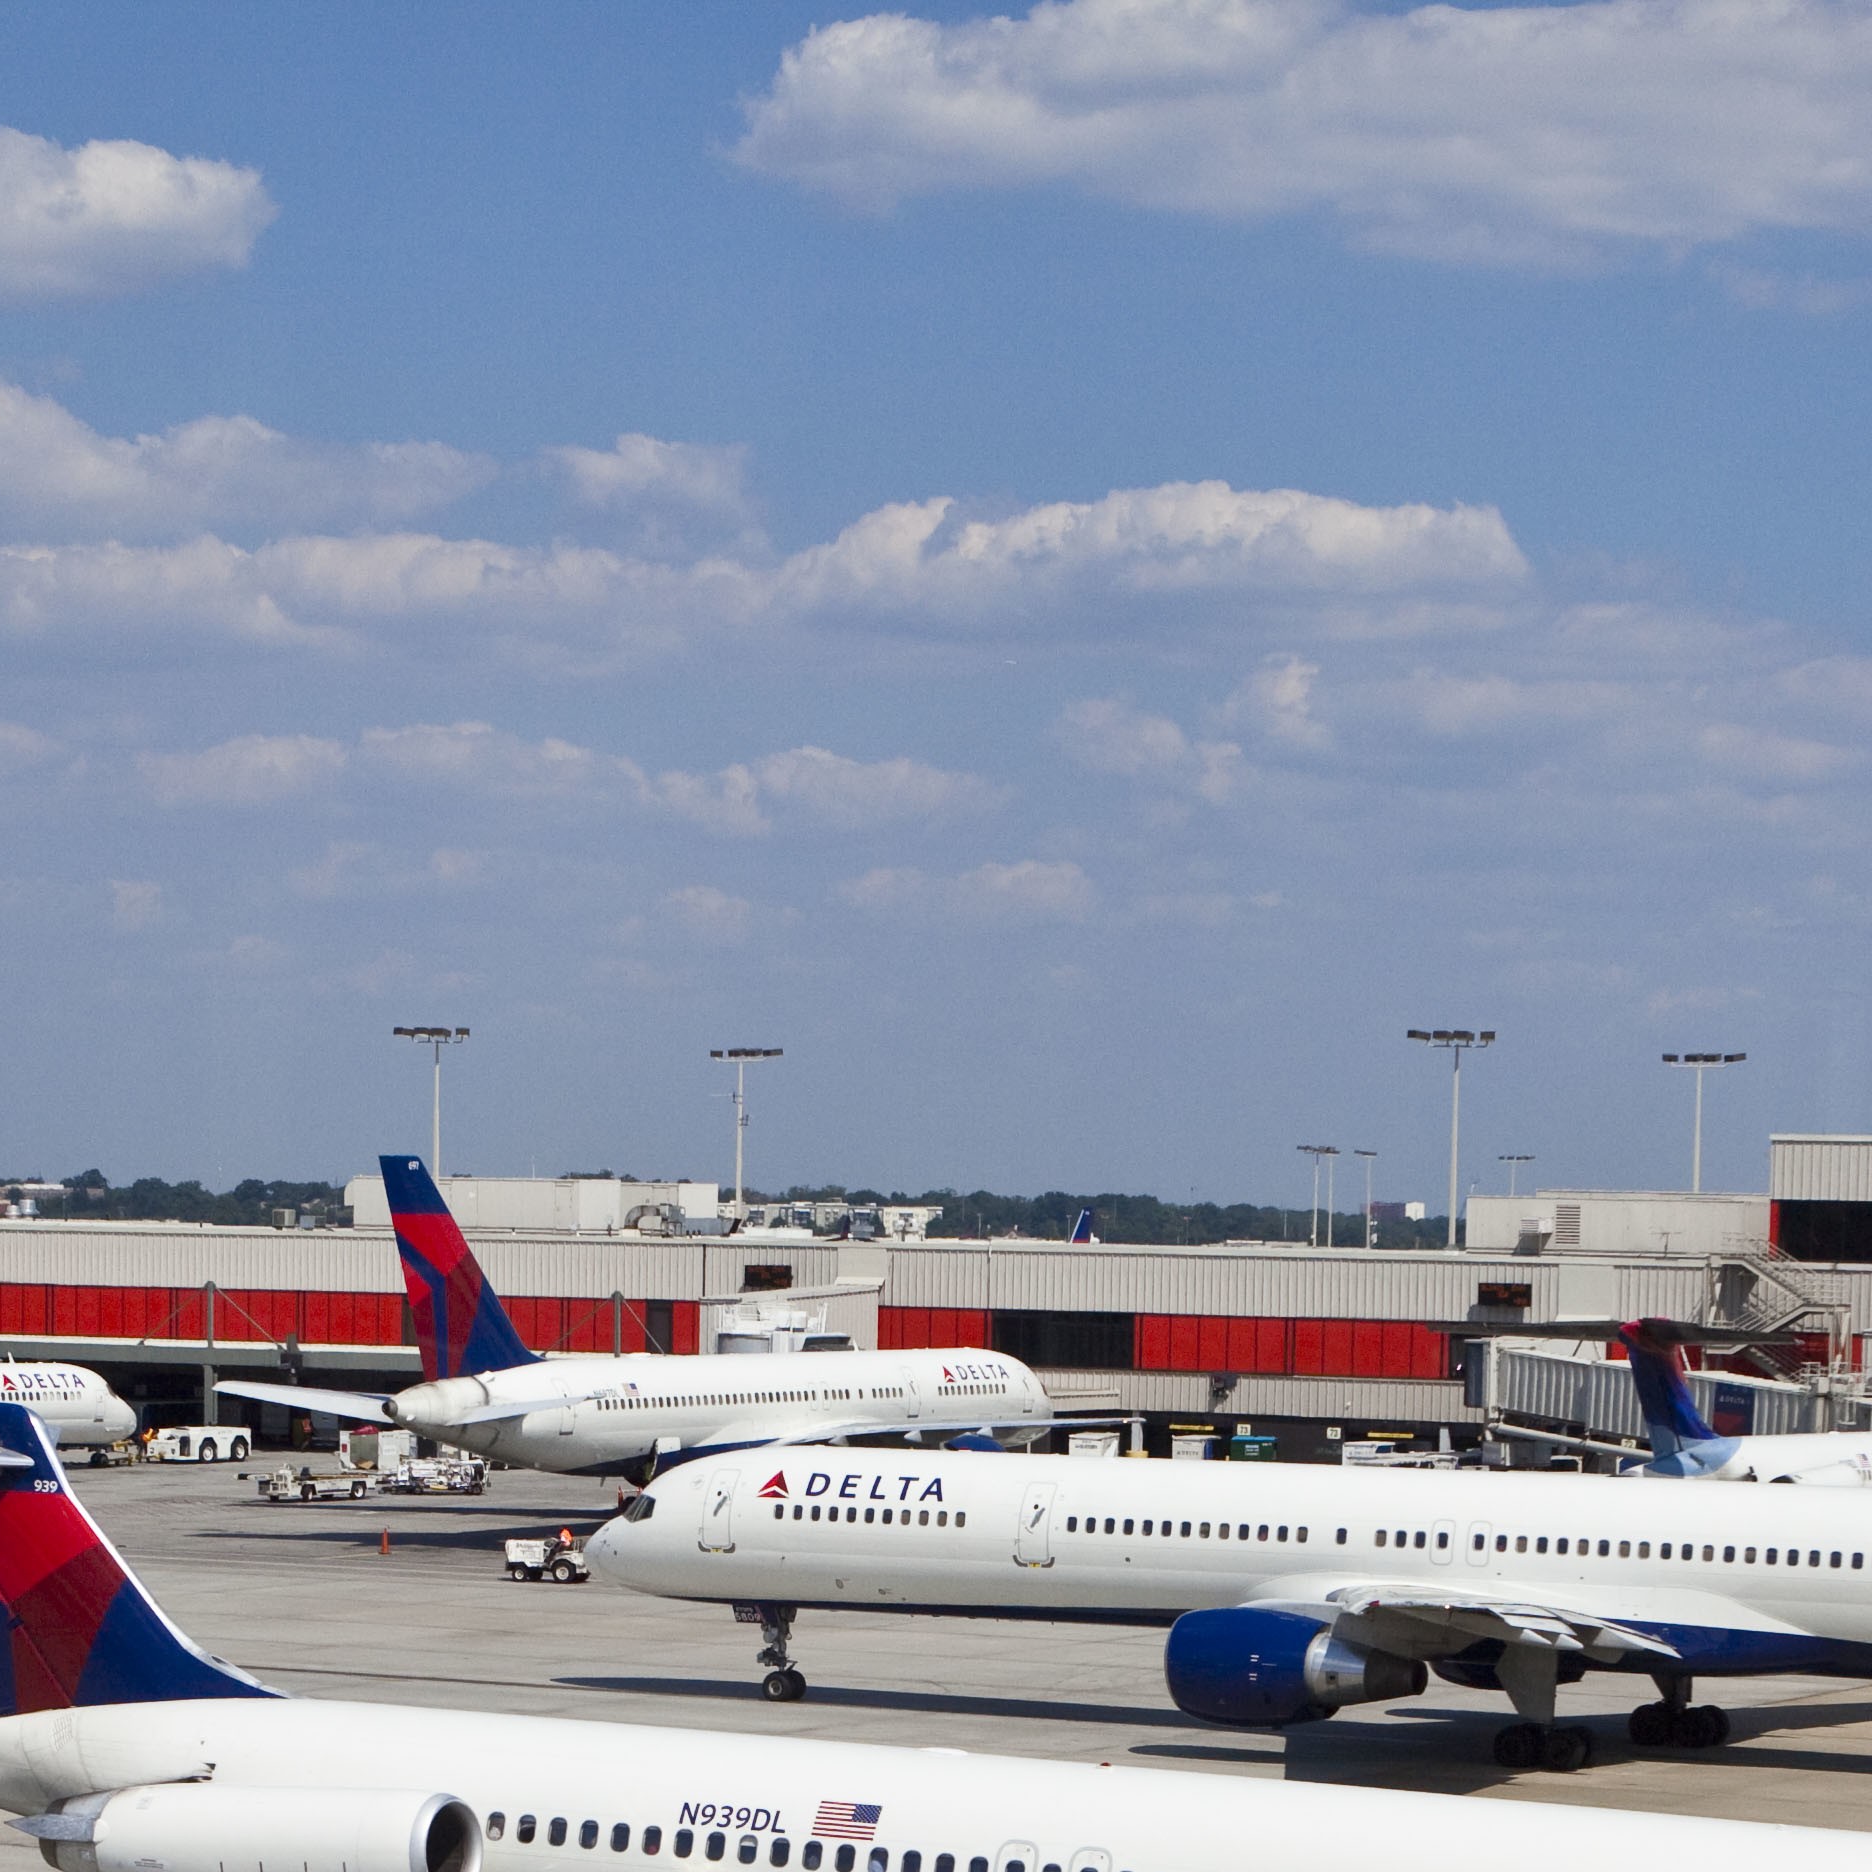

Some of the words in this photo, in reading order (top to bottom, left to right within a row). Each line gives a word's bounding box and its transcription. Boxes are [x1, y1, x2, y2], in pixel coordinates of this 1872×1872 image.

[956, 1365, 1009, 1380] DELTA
[19, 1374, 85, 1389] DELTA
[34, 1480, 58, 1493] 939
[805, 1473, 943, 1502] DELTA
[735, 1612, 760, 1621] 5809
[679, 1802, 786, 1834] N939DL
